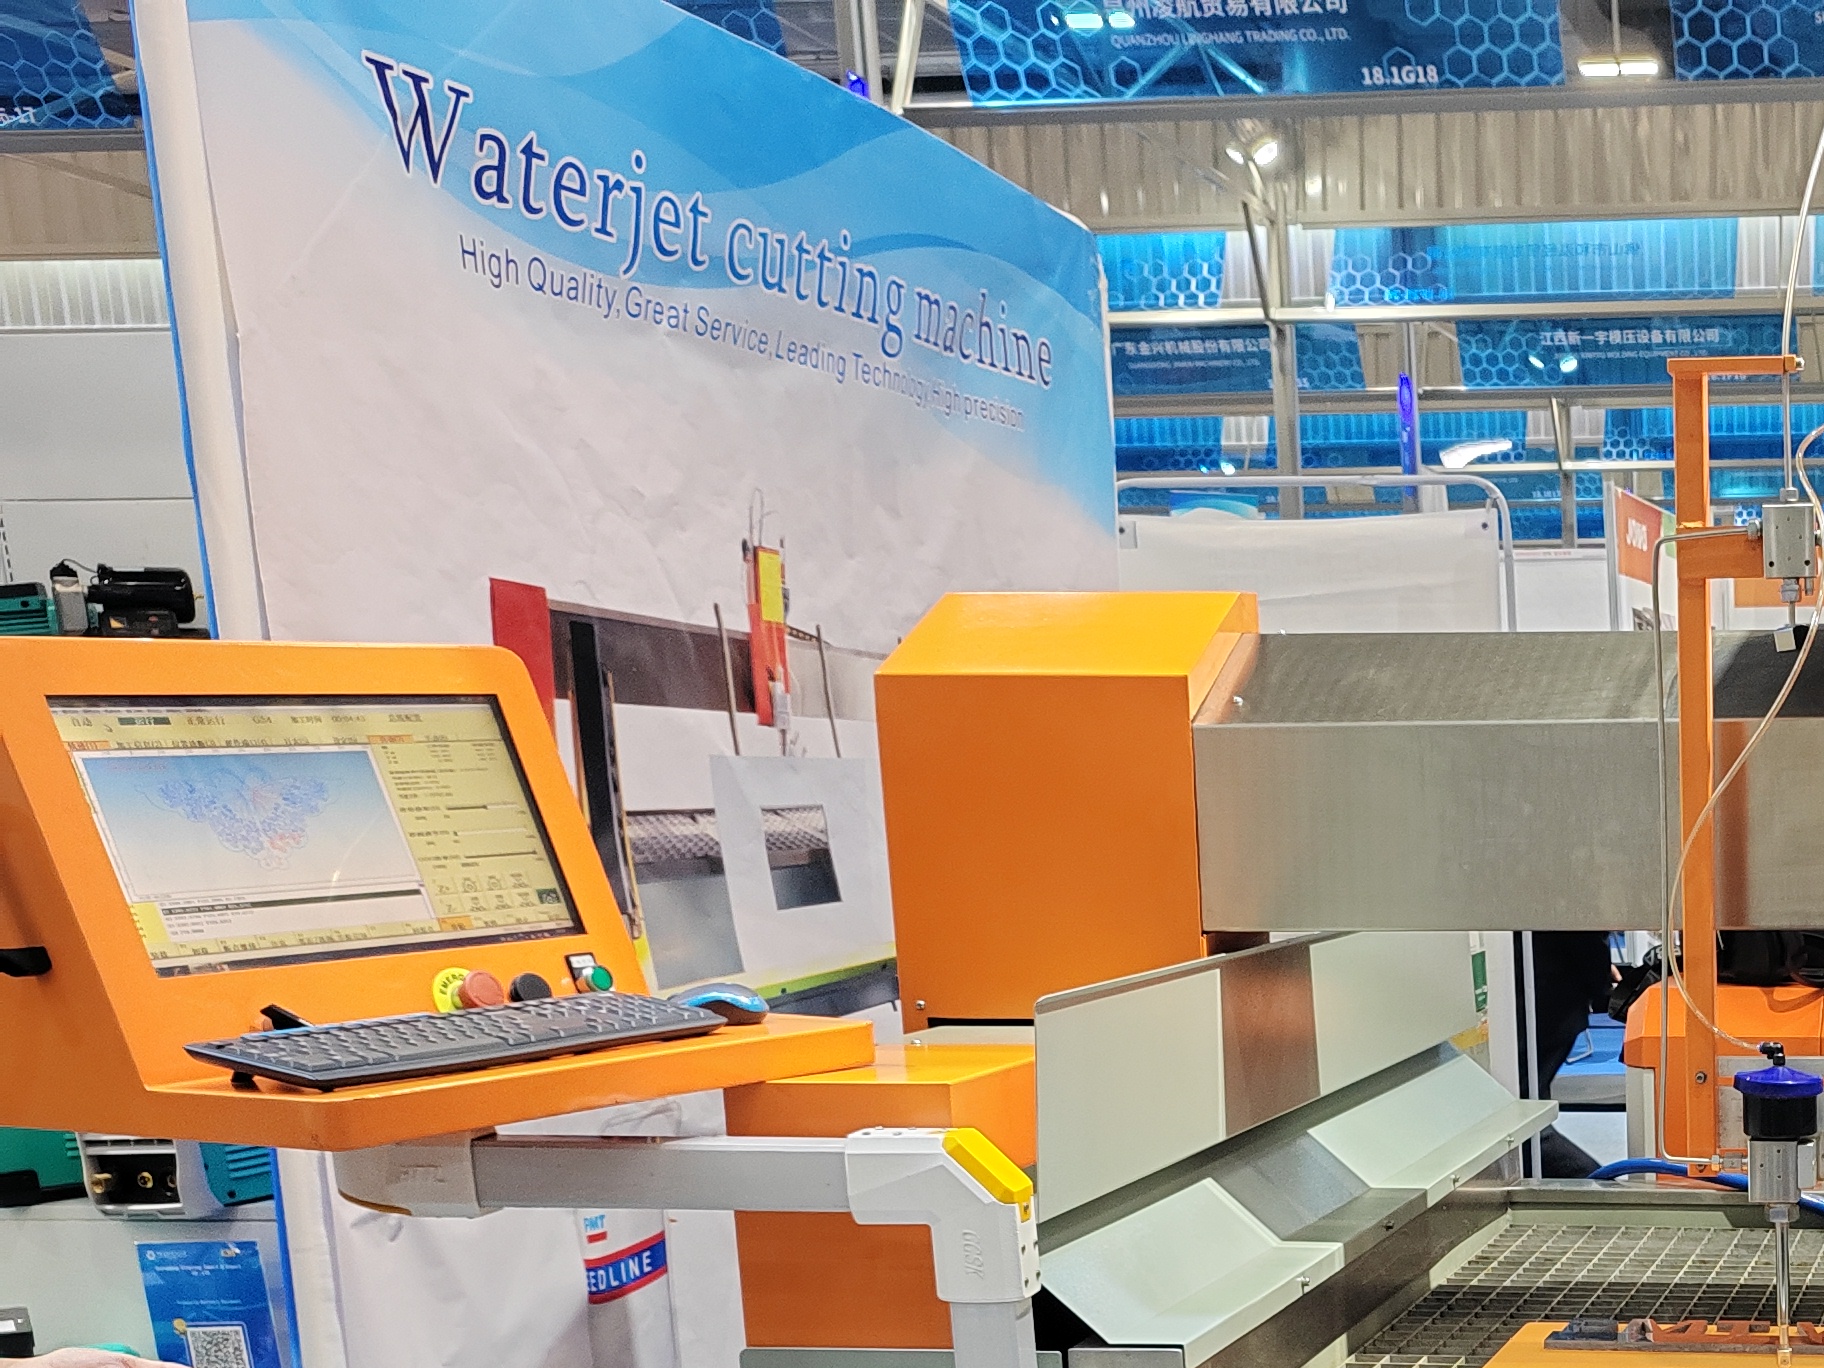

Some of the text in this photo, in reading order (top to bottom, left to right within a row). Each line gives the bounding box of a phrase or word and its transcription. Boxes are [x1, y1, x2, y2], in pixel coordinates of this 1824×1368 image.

[1245, 29, 1298, 43] TRADING
[1361, 64, 1438, 86] 18.1G18
[361, 50, 1052, 388] Waterjet cutting machine
[458, 233, 520, 289] High
[586, 1250, 653, 1292] EDLINE
